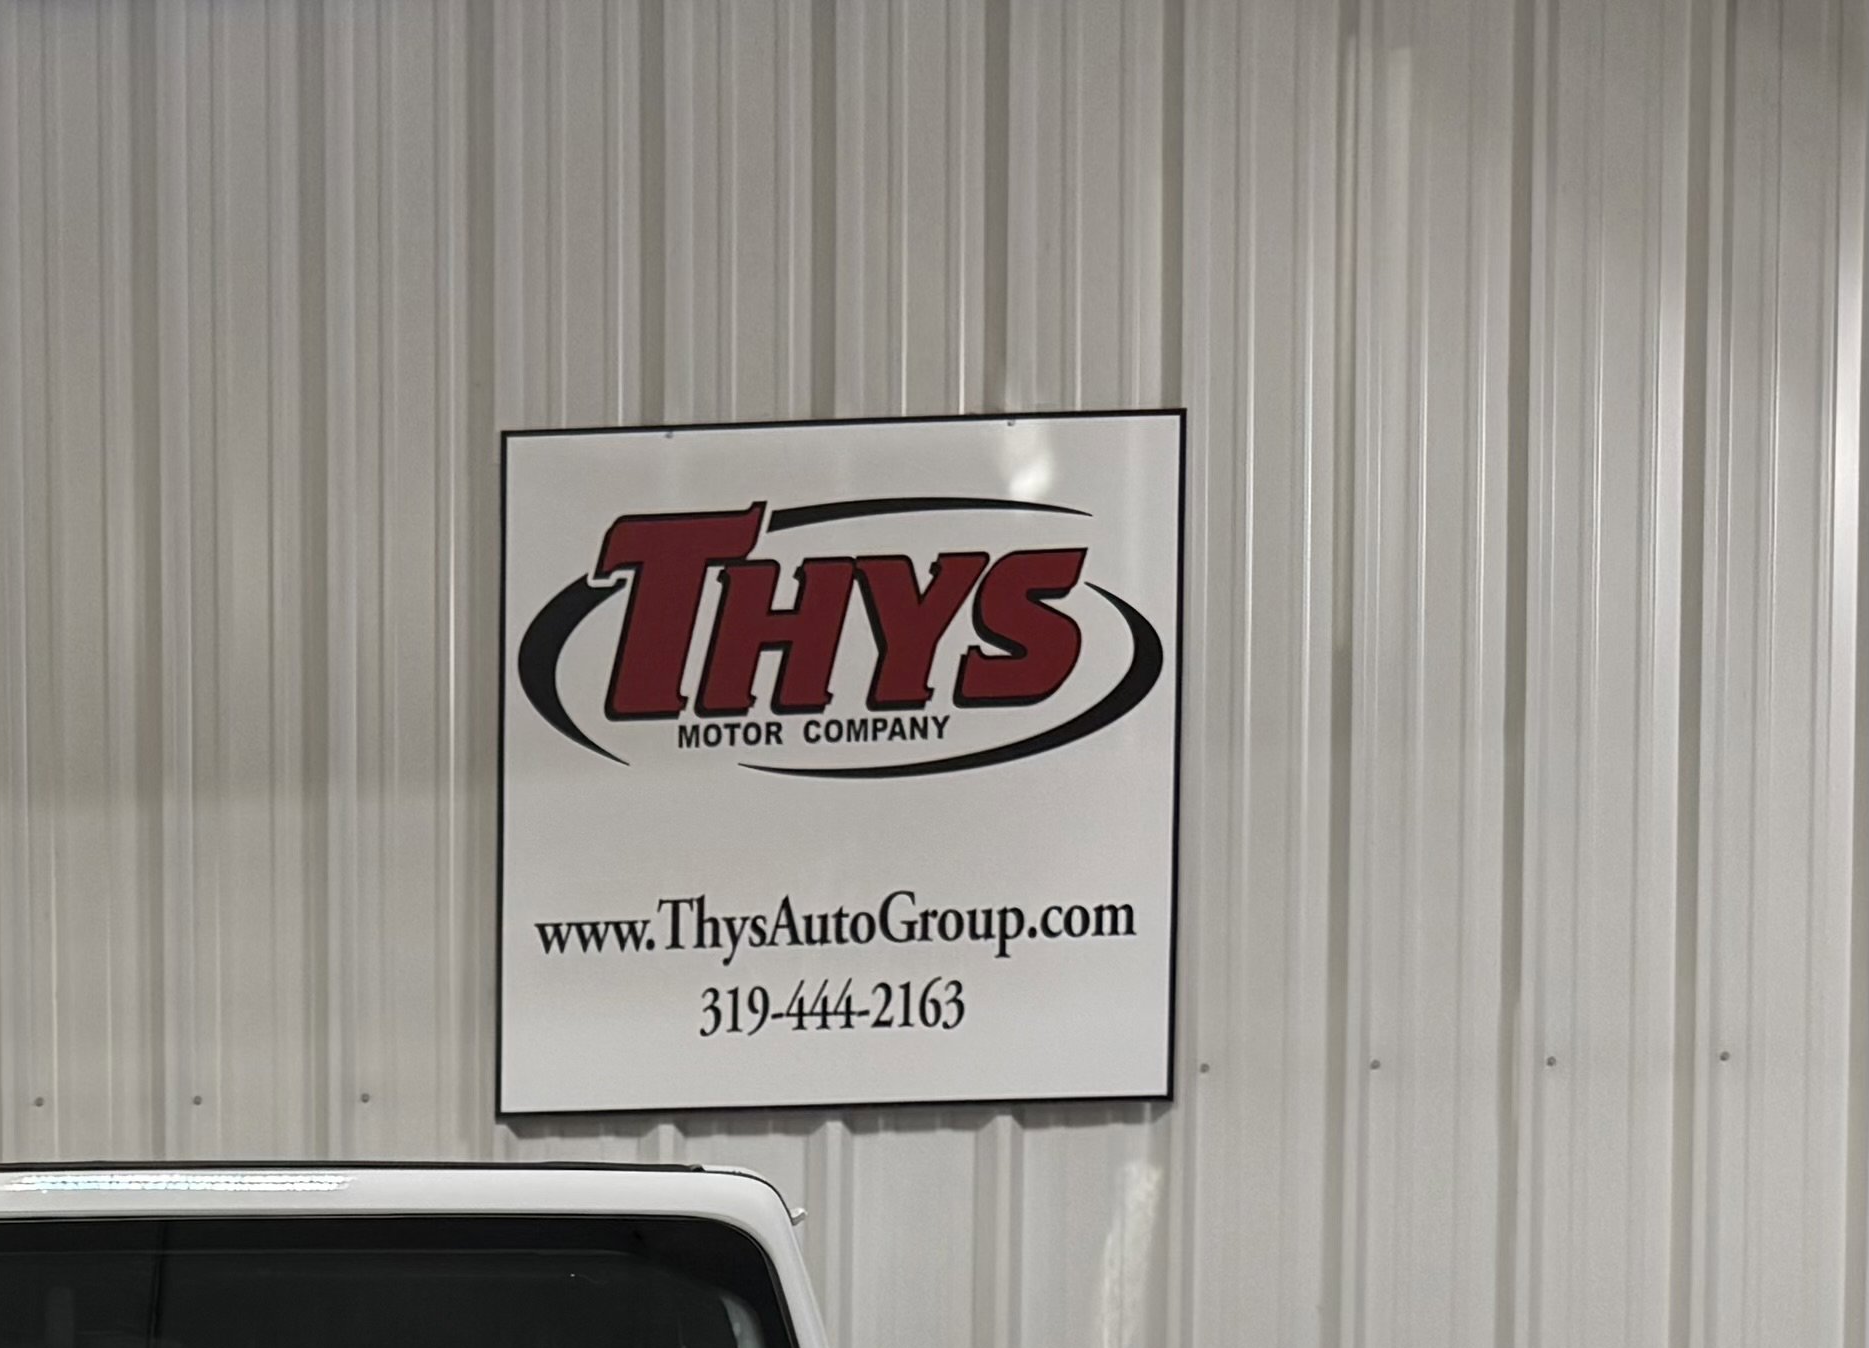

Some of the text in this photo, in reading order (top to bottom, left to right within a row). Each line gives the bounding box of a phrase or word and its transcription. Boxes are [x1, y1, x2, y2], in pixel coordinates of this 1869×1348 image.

[593, 500, 1089, 722] THYS
[677, 715, 952, 749] MOTOR COMPANY
[534, 890, 1138, 965] www.ThysAutoGroup.com
[698, 977, 966, 1037] 319-444-2163
